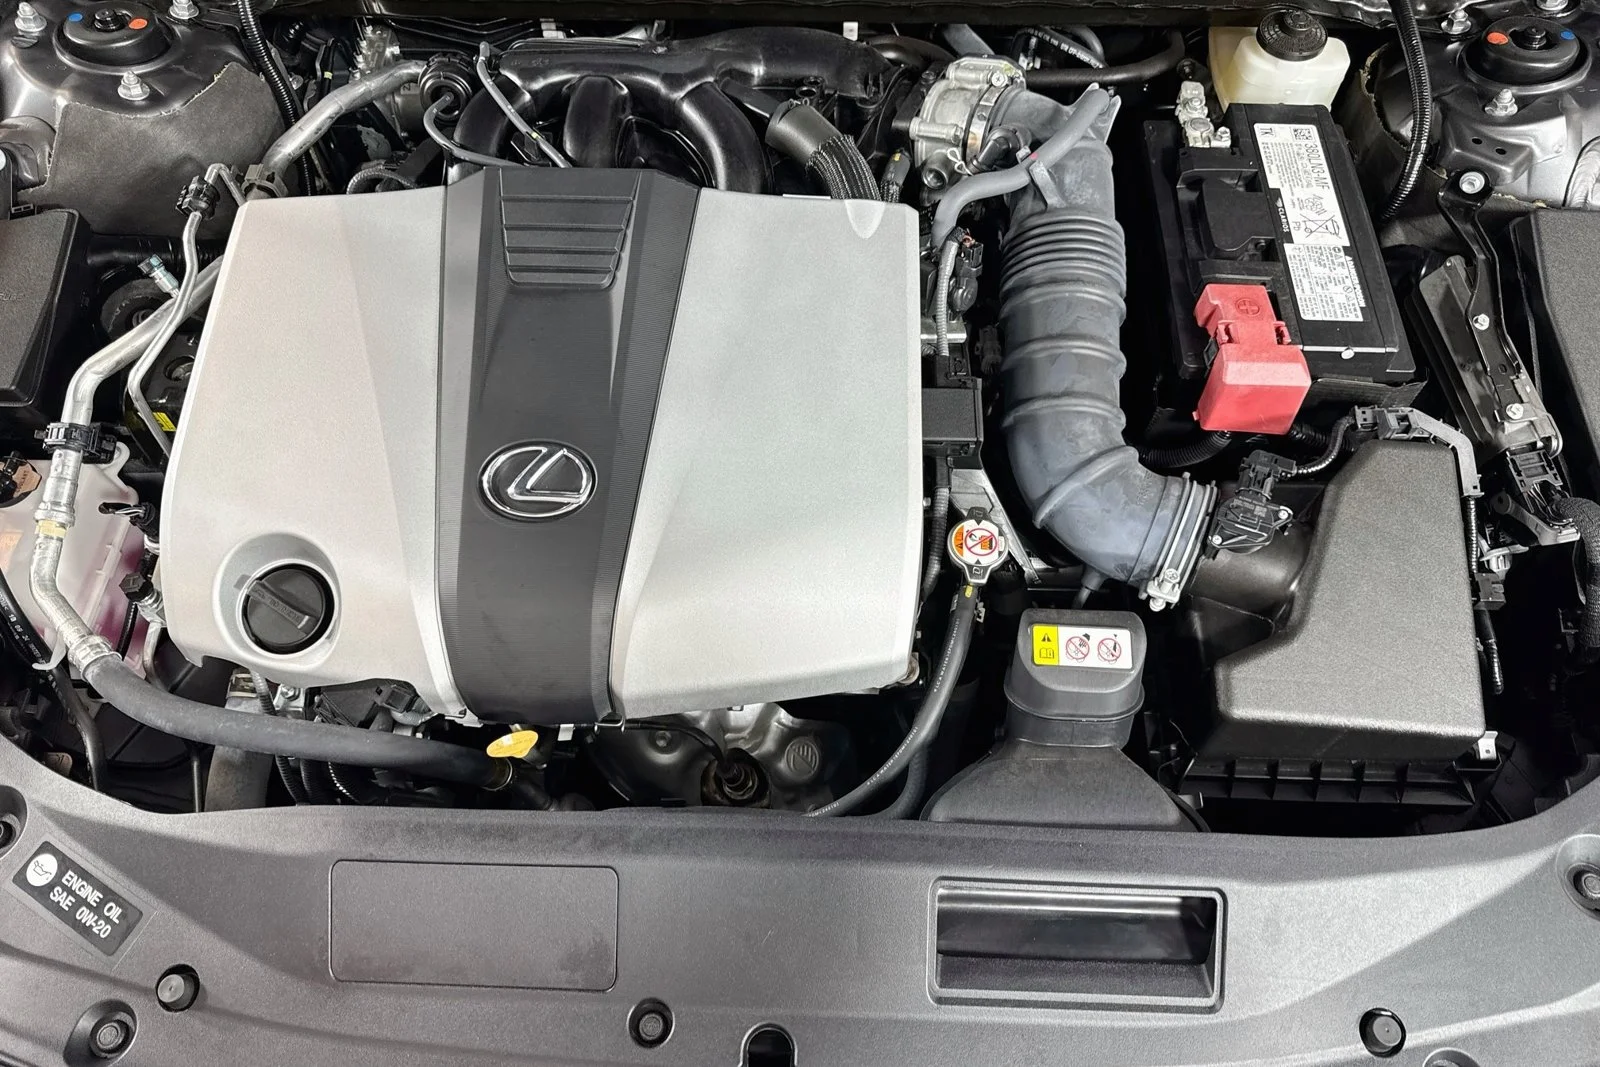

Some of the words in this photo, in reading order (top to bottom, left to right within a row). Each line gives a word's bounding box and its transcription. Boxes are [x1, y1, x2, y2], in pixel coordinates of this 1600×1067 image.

[1260, 127, 1274, 136] TK
[1304, 143, 1330, 190] 380LN3-MF
[1278, 207, 1289, 233] CLARIOS
[1292, 221, 1301, 231] Pb
[49, 886, 76, 911] SAE
[75, 906, 112, 939] 0W-20
[61, 870, 103, 907] ENGINE
[103, 902, 124, 925] OIL
